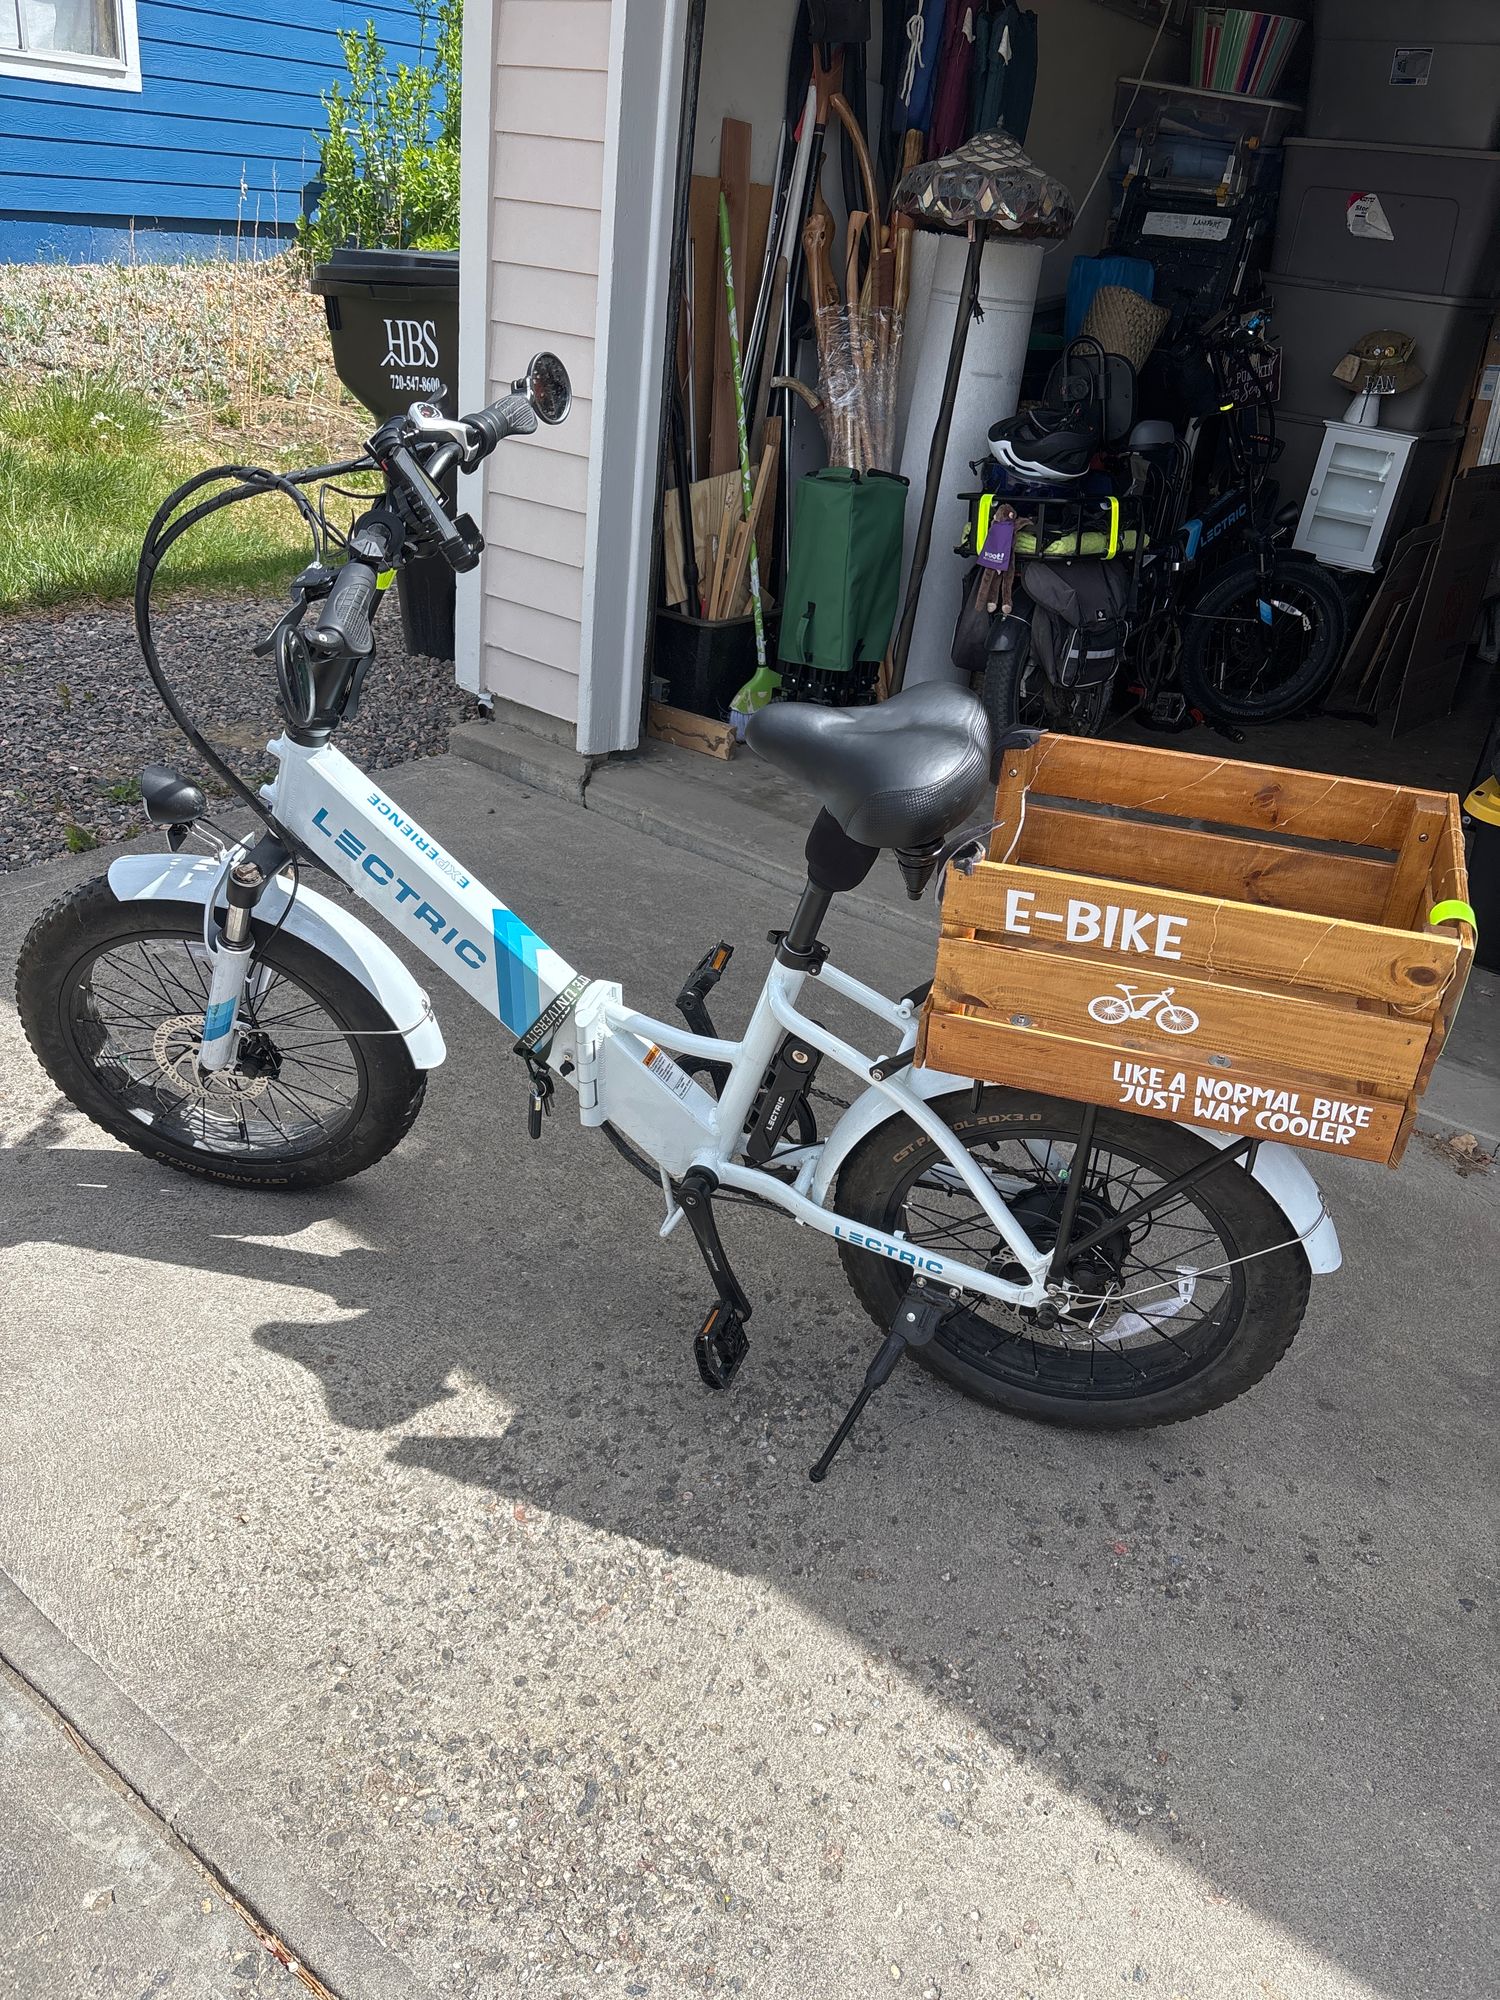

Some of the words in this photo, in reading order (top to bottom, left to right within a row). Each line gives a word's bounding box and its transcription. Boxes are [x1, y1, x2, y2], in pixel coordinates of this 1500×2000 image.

[380, 319, 439, 368] HBS
[390, 374, 440, 392] 720-547-8600
[1240, 381, 1274, 402] Seasn
[1200, 503, 1248, 547] LECTRIC
[367, 793, 470, 889] EXPERIENCE
[312, 807, 487, 969] LECTRIC
[1004, 889, 1189, 961] E-BIKE
[522, 988, 579, 1047] UNIVERSITY
[766, 1096, 786, 1131] LECTRIC
[1112, 1060, 1163, 1089] LIKE
[1169, 1070, 1186, 1093] A
[1195, 1077, 1301, 1115] NORMAL
[1313, 1098, 1374, 1129] BIKE
[1120, 1083, 1185, 1114] JUST
[1193, 1097, 1246, 1126] WAY
[1254, 1109, 1357, 1145] COOLER
[892, 1143, 915, 1164] CST
[916, 1121, 975, 1147] POL
[976, 1113, 1042, 1125] 20X3.0
[211, 1169, 261, 1185] PATROL
[834, 1224, 945, 1276] LECTRIC
